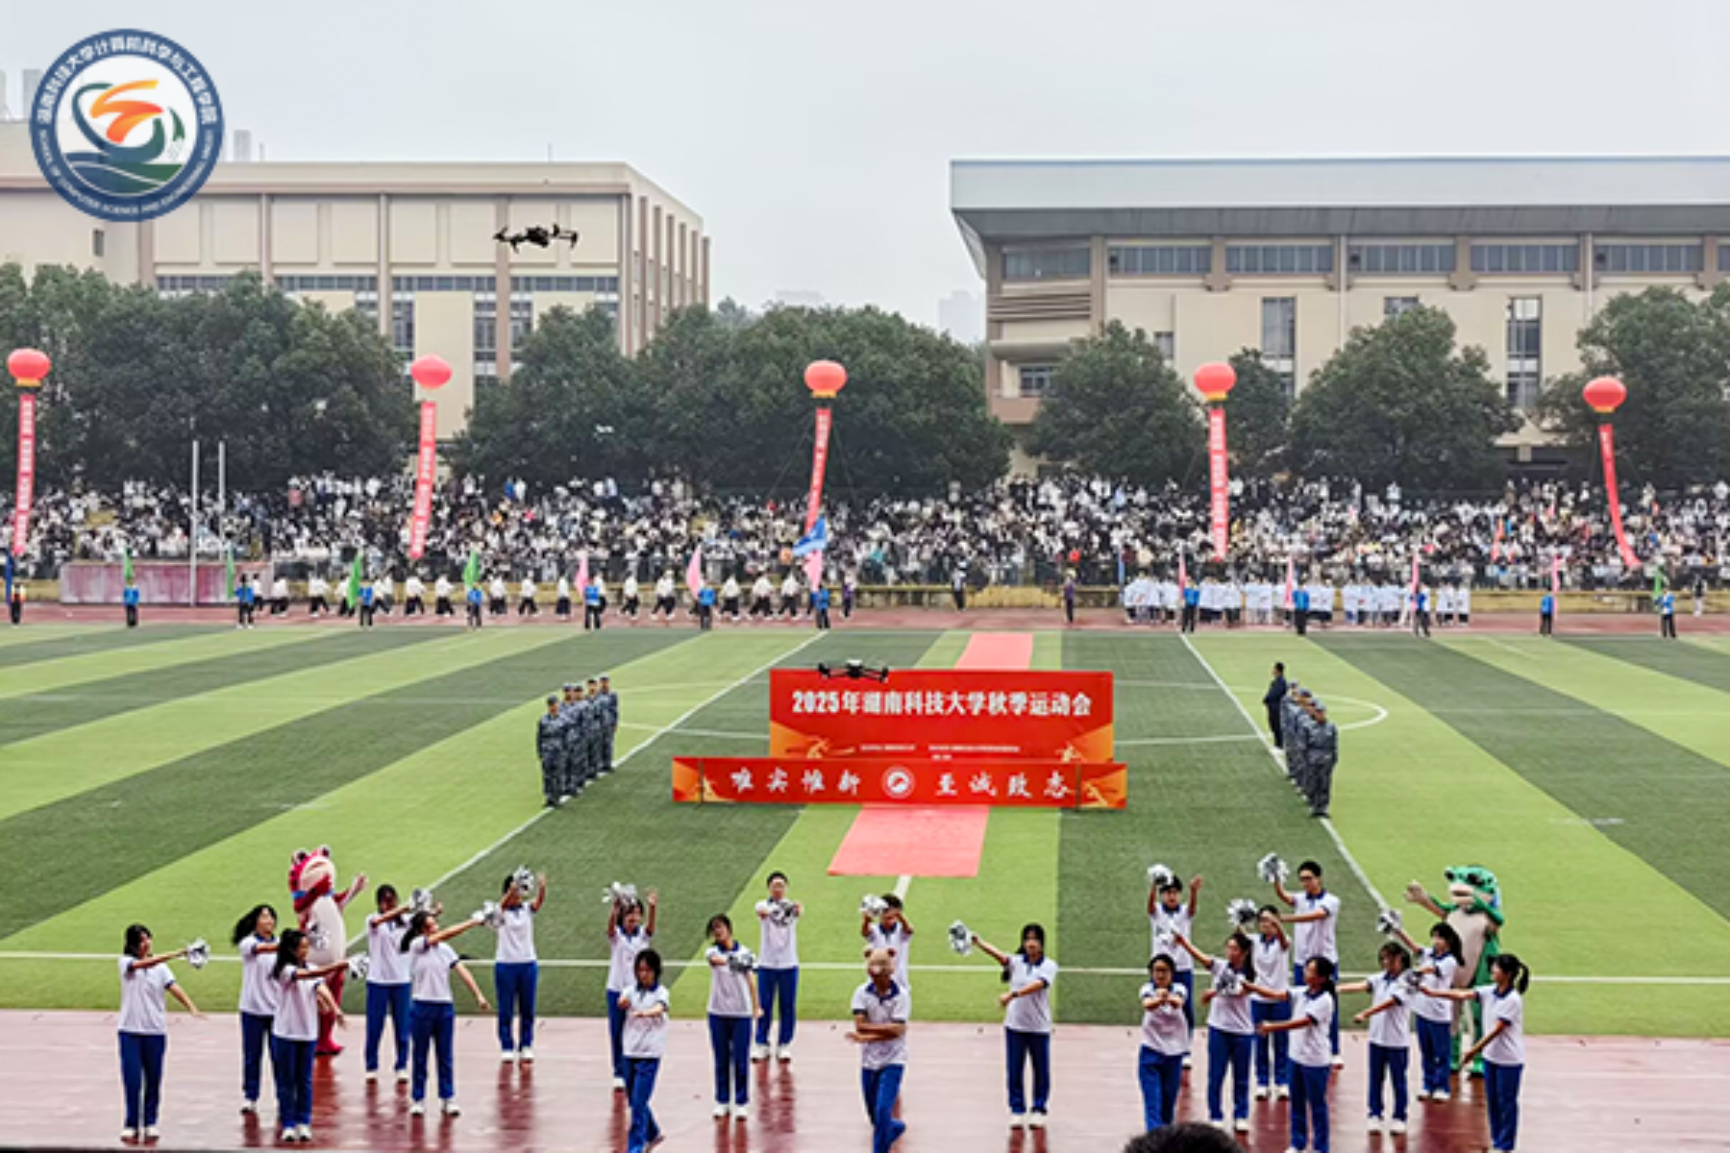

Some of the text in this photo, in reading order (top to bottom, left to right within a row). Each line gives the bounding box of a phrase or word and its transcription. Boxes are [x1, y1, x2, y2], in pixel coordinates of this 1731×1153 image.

[791, 690, 1092, 717] 2025年湖南科技大学秋季运动会
